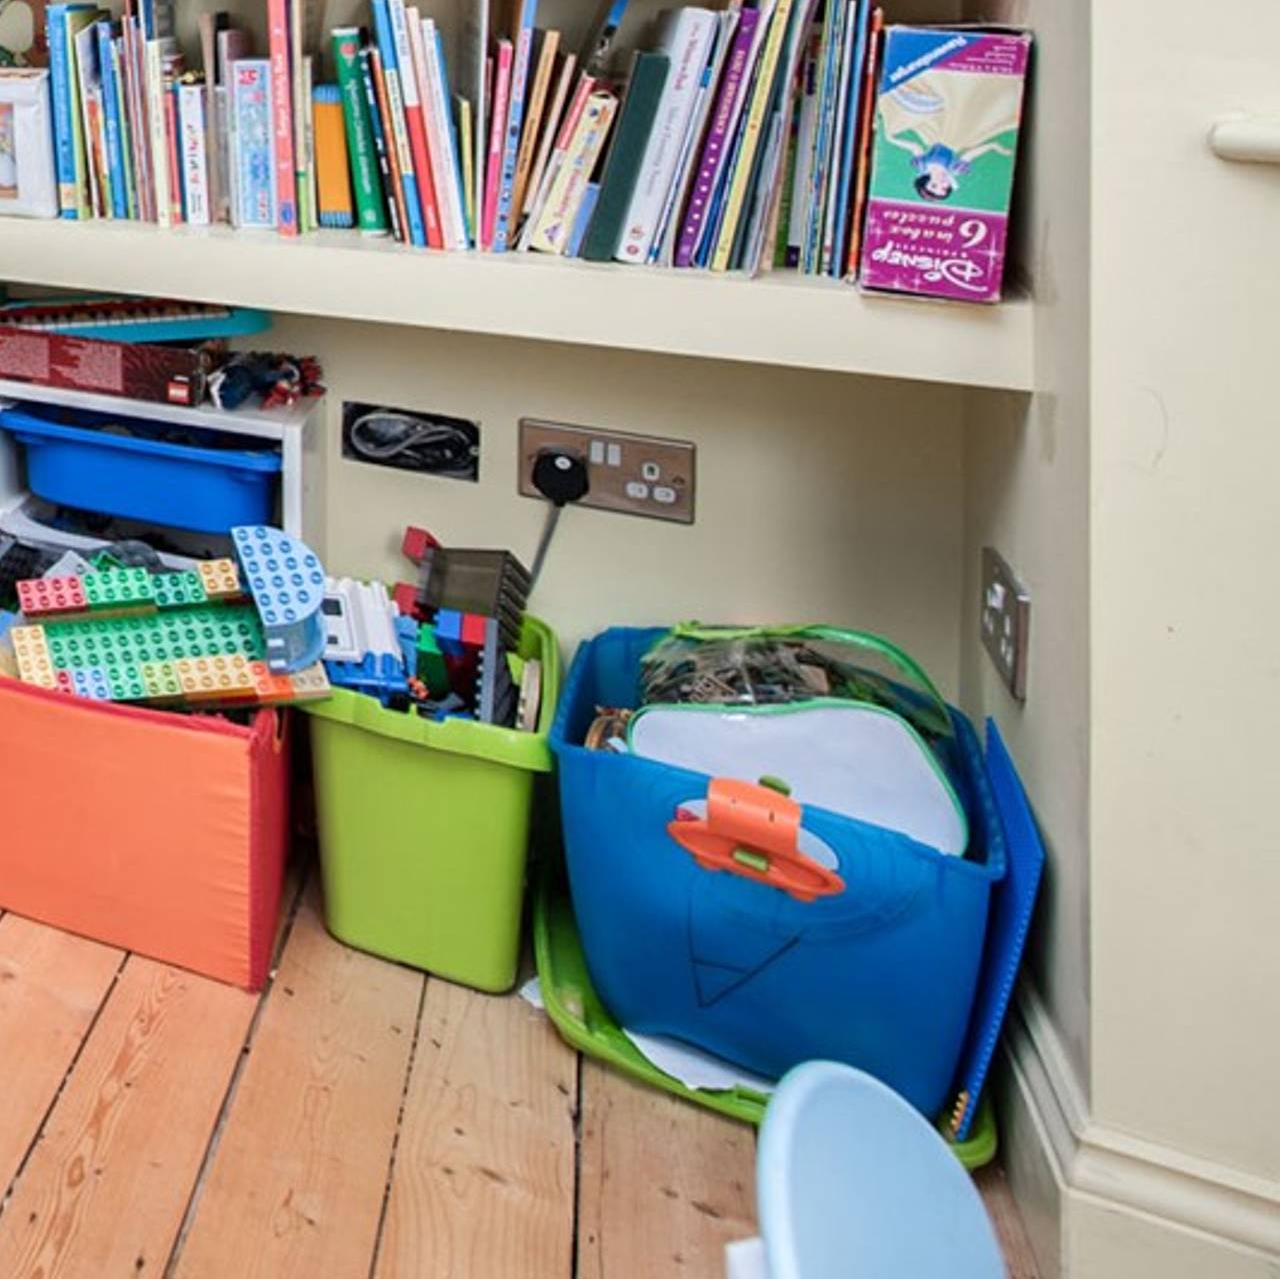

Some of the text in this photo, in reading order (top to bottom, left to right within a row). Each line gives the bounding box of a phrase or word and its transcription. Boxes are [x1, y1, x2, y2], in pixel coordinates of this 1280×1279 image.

[883, 210, 955, 227] puzzles
[889, 224, 922, 241] box
[958, 219, 987, 248] 6
